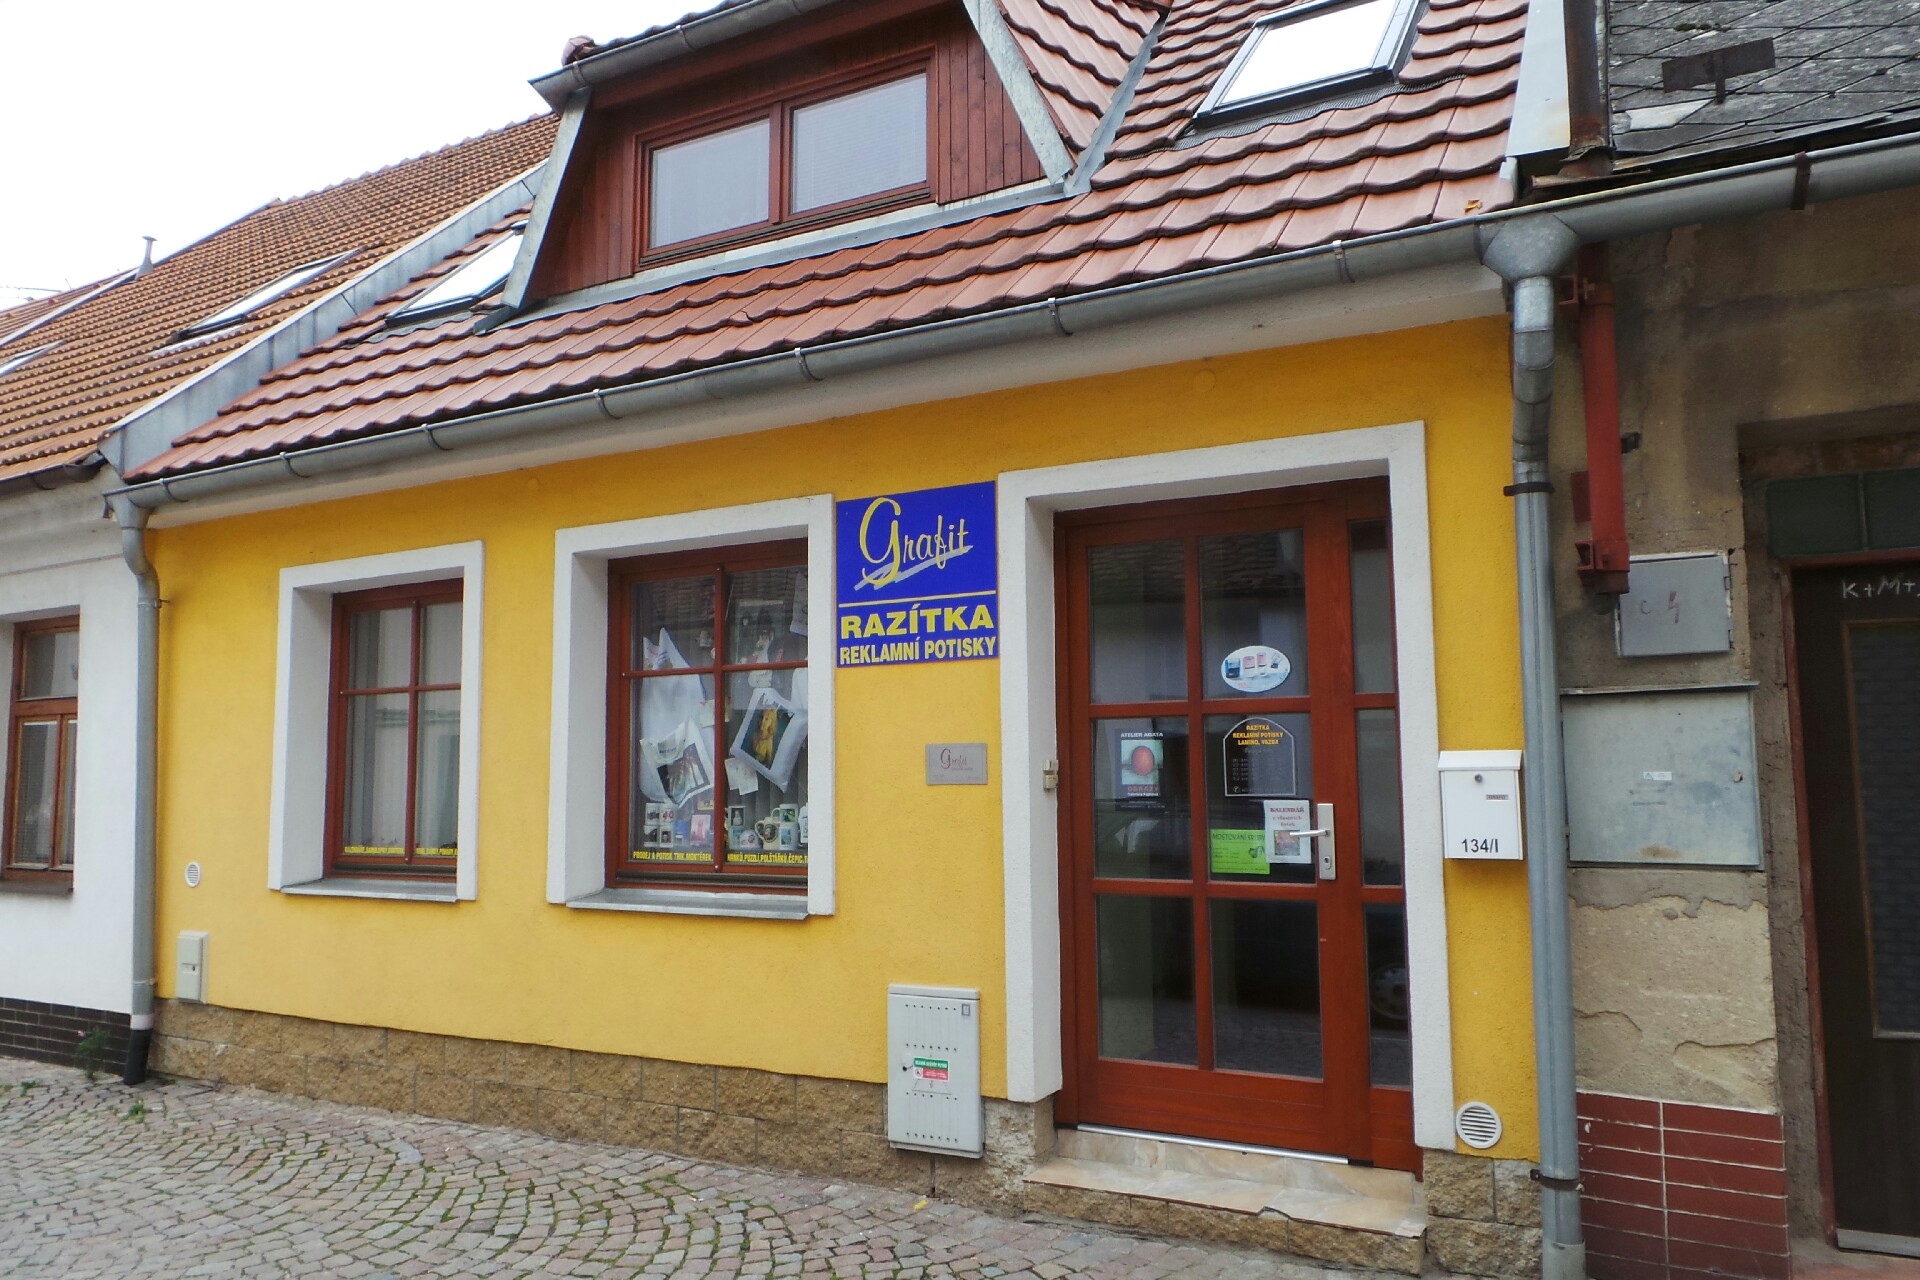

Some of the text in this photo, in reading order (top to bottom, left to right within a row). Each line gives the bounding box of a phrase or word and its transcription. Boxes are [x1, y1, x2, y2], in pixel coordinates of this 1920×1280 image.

[859, 497, 969, 585] Grafit
[840, 603, 994, 639] RAZÍTKA
[840, 636, 997, 665] REKLAMNÍ POTISKY
